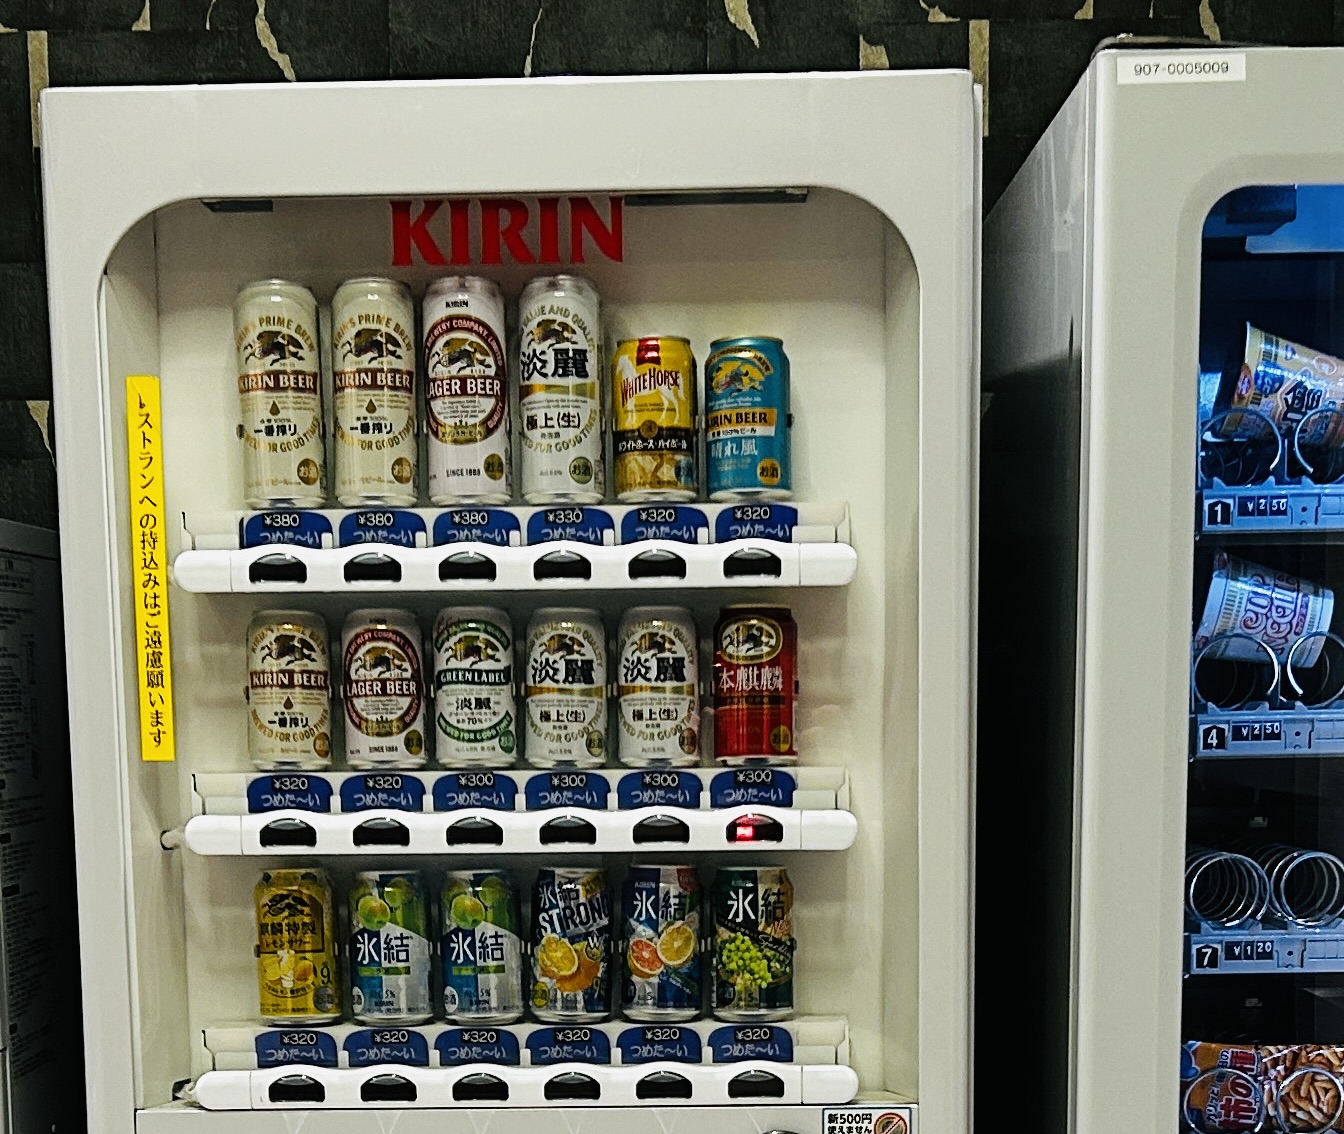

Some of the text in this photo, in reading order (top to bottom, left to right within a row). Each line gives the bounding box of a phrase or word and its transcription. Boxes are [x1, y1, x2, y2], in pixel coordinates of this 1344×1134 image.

[390, 196, 624, 268] KIRIN
[520, 349, 589, 381] 淡麗
[240, 374, 314, 391] KIRIN BEER
[336, 373, 410, 389] KIRIN BEER
[467, 379, 500, 394] BEER
[621, 368, 679, 407] WHITE HORSE
[736, 411, 768, 424] BEER
[254, 424, 297, 436] 一番搾り
[350, 423, 393, 435] 一番搾り
[358, 513, 393, 526] ¥380
[452, 512, 488, 524] ¥380
[547, 510, 583, 523] ¥330
[639, 509, 675, 522] ¥320
[734, 507, 770, 519] ¥320
[1215, 504, 1222, 523] 1
[264, 514, 299, 526] ¥380
[531, 658, 595, 684] 淡麗
[623, 657, 686, 682] 淡麗
[252, 673, 325, 686] KIRIN BEER
[441, 672, 505, 683] GREEN LABEL
[719, 666, 783, 692] 本麒麟
[347, 681, 416, 696] LAGER BEER
[1208, 729, 1217, 747] 4
[367, 776, 402, 789] ¥320
[458, 774, 493, 786] ¥300
[551, 774, 586, 787] ¥300
[643, 773, 679, 786] ¥300
[737, 770, 772, 783] ¥300
[273, 778, 308, 790] ¥320
[633, 890, 686, 921] 氷結
[728, 889, 785, 922] 氷結
[357, 933, 410, 964] 氷結
[450, 932, 504, 964] 氷結
[1202, 949, 1212, 966] 7
[283, 1033, 317, 1044] ¥320
[374, 1030, 409, 1043] ¥320
[462, 1031, 497, 1043] ¥320
[556, 1029, 590, 1041] ¥320
[645, 1028, 680, 1040] ¥320
[736, 1028, 770, 1040] ¥320
[1217, 1049, 1258, 1130] 柿の種
[828, 1113, 872, 1125] 新500円
[828, 1126, 872, 1134] 使えません
